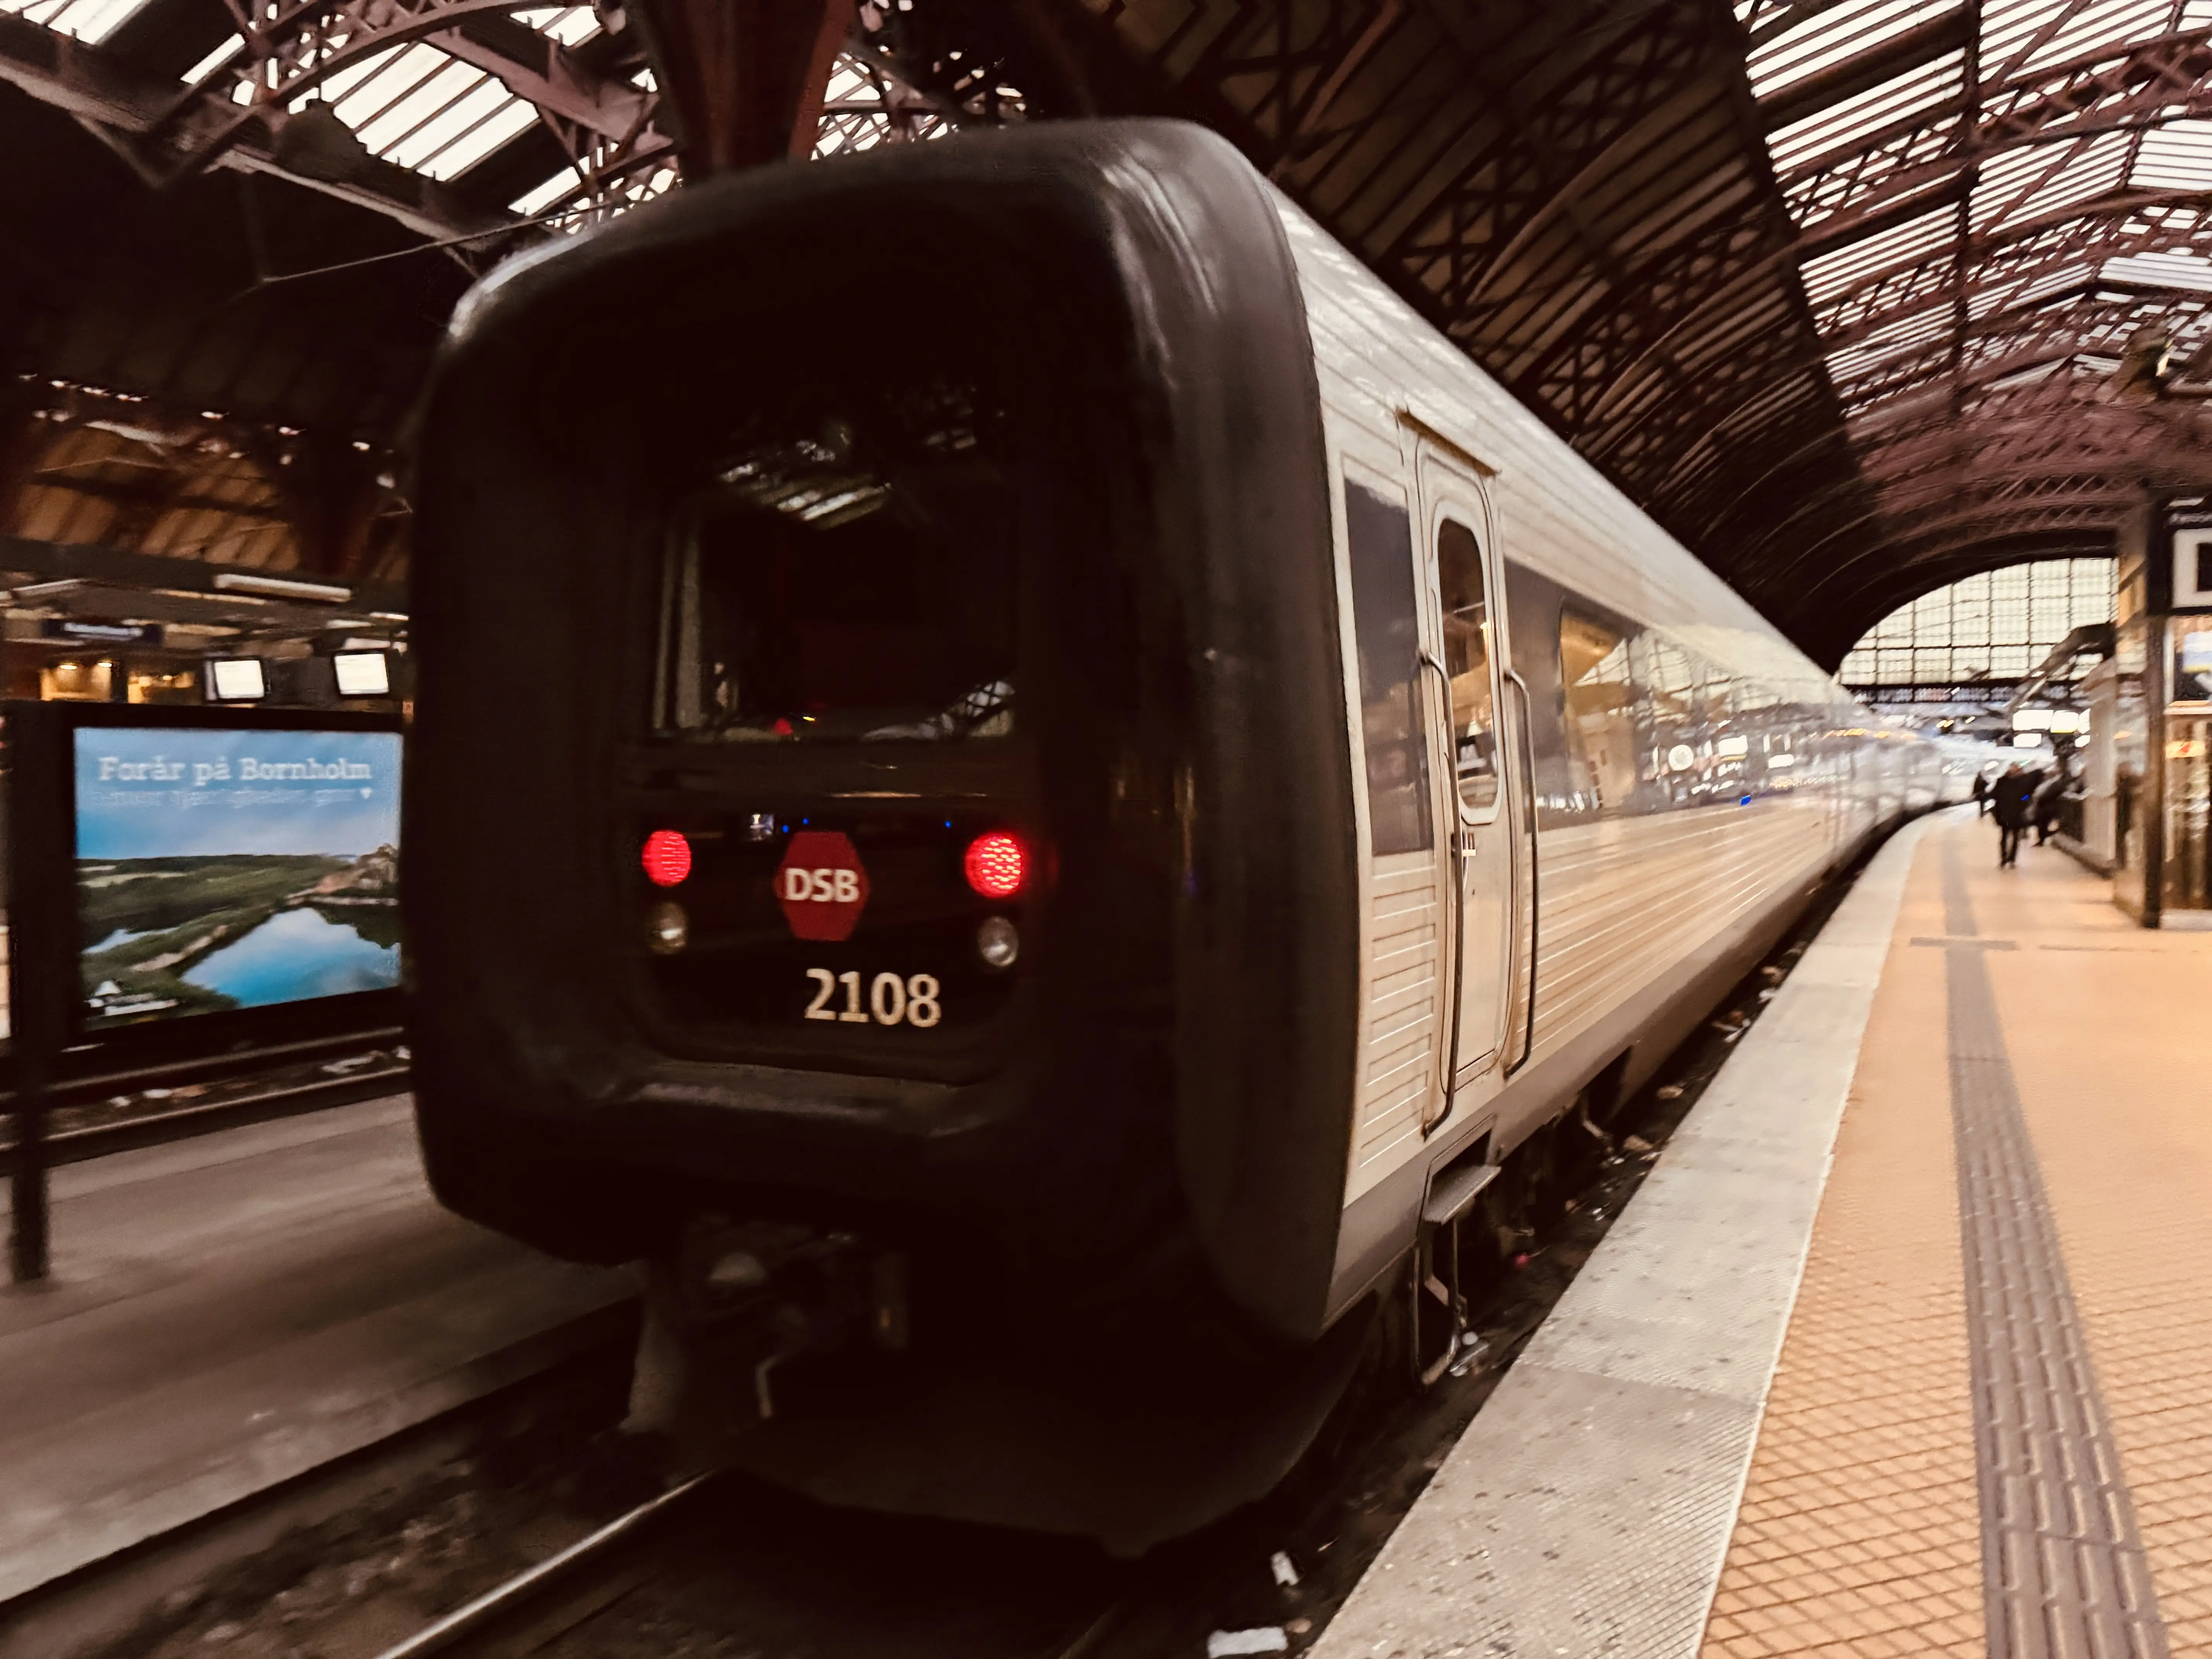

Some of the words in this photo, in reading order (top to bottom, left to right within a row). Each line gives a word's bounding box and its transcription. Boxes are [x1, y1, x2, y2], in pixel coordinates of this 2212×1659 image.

[98, 756, 185, 781] Forår
[192, 757, 231, 786] på
[239, 758, 373, 780] Bornholm
[785, 868, 860, 902] DSB
[804, 968, 942, 1027] 2108
